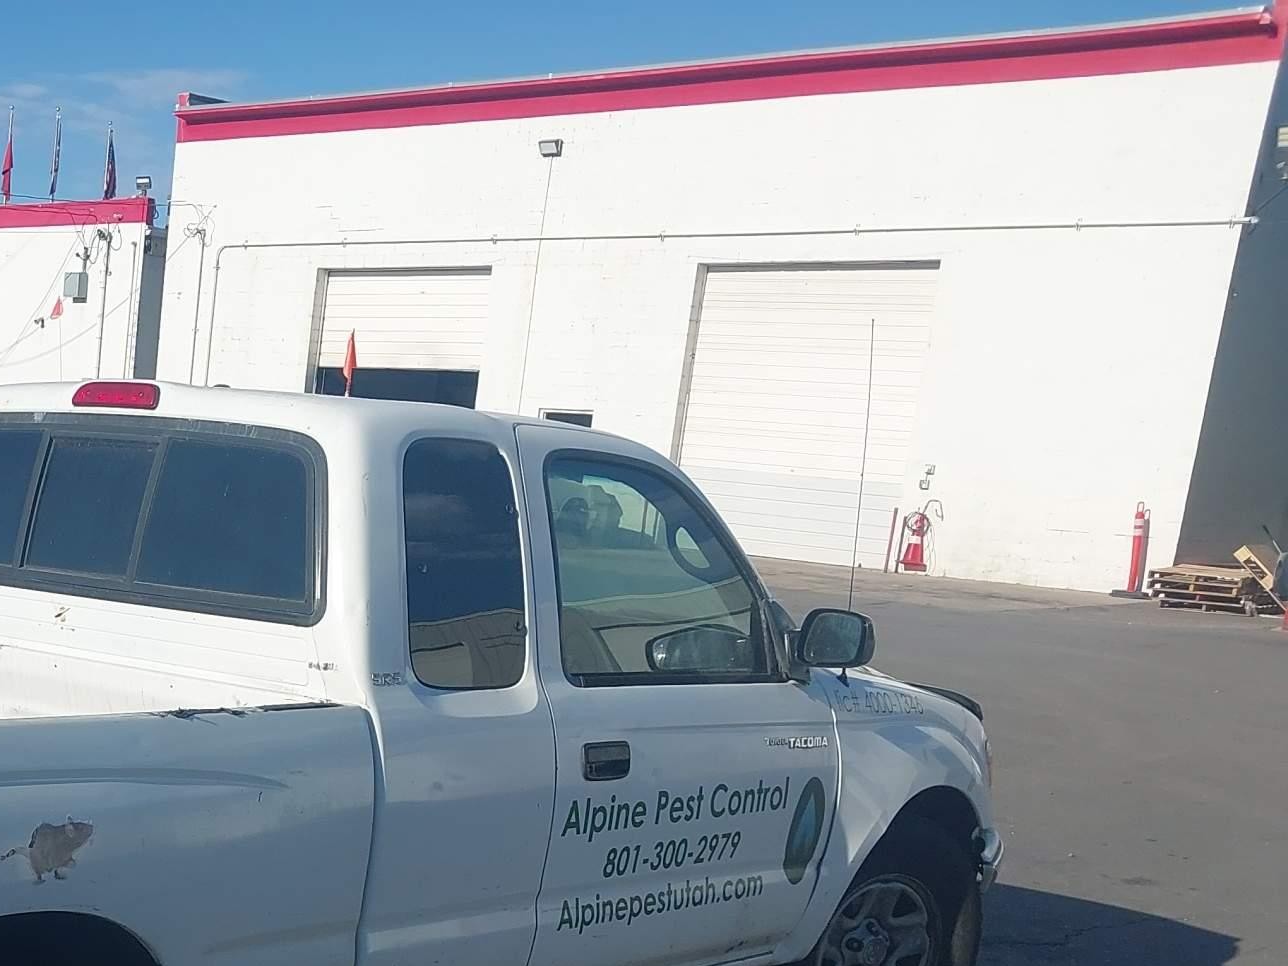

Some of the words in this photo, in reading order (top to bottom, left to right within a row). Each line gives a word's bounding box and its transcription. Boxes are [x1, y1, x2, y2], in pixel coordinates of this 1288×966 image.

[788, 736, 829, 749] TACOMA
[560, 794, 647, 843] Alpine
[654, 785, 705, 825] Pest
[710, 776, 791, 818] Control
[602, 831, 742, 879] 801-300-2979
[556, 873, 764, 935] Alpinepestutah.com
